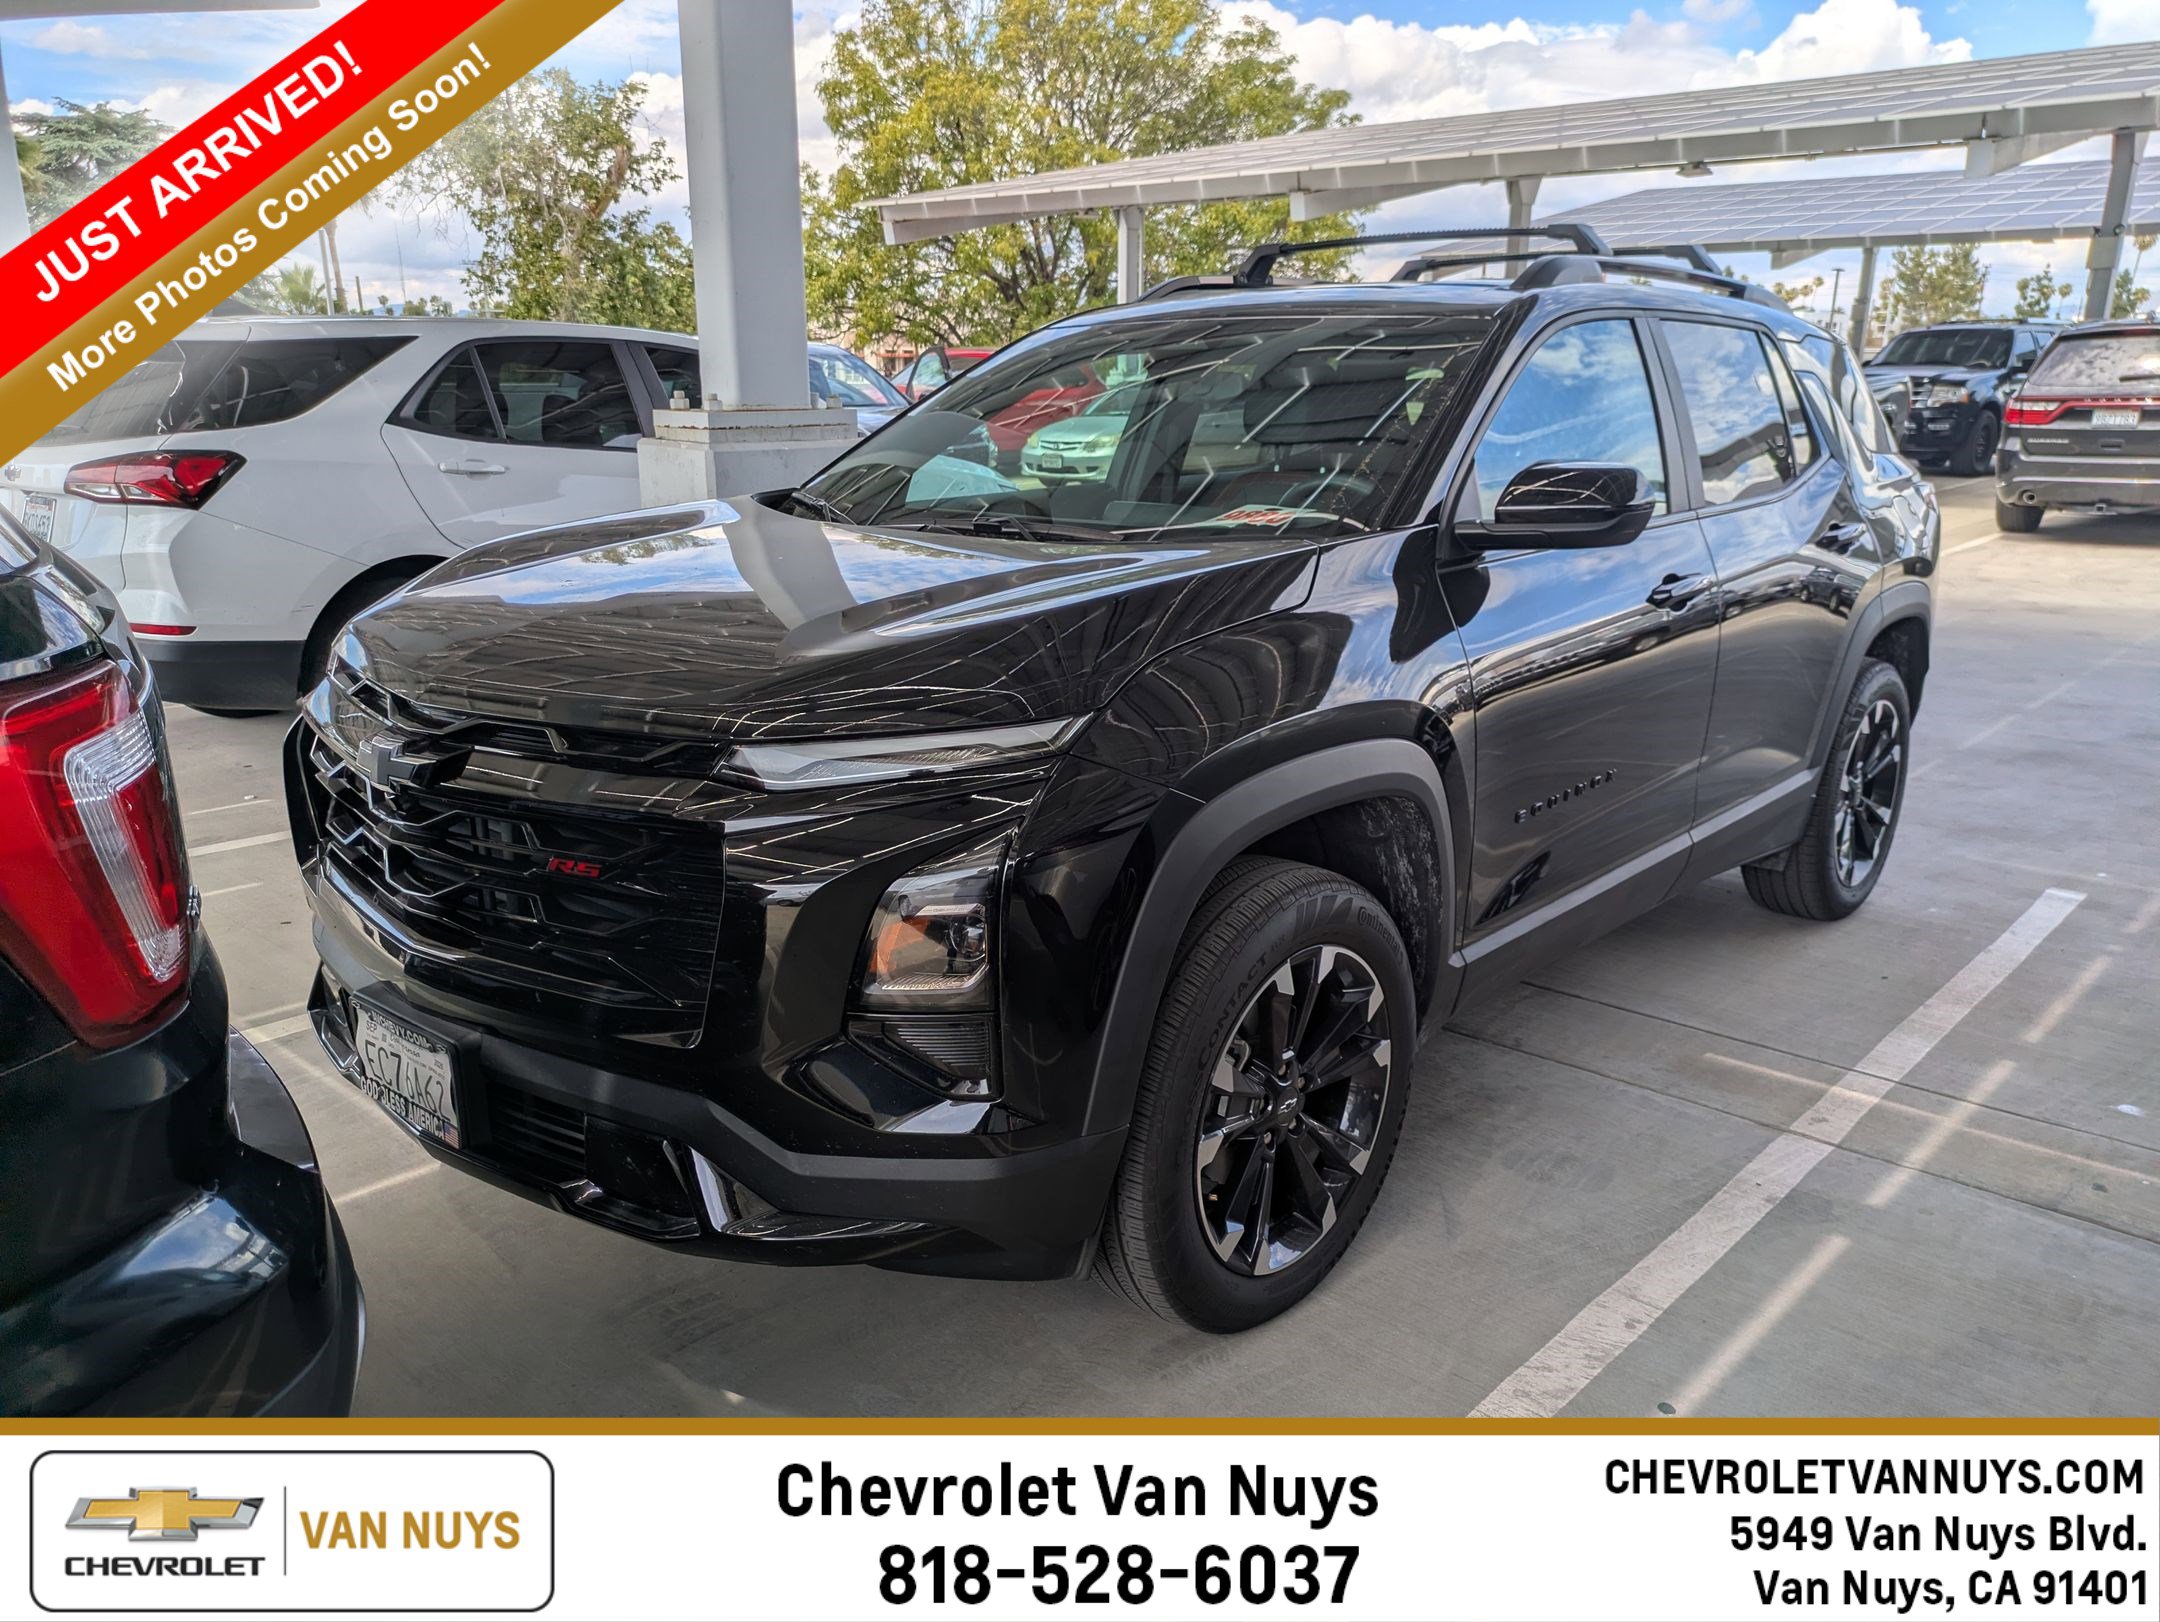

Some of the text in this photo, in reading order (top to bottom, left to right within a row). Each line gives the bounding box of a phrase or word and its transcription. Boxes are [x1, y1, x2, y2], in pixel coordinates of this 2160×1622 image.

[1514, 768, 1617, 824] EQUINOX
[547, 856, 602, 879] RS
[360, 1076, 379, 1100] GOD
[408, 1101, 445, 1140] AMERICA
[365, 1039, 452, 1122] EC76A62
